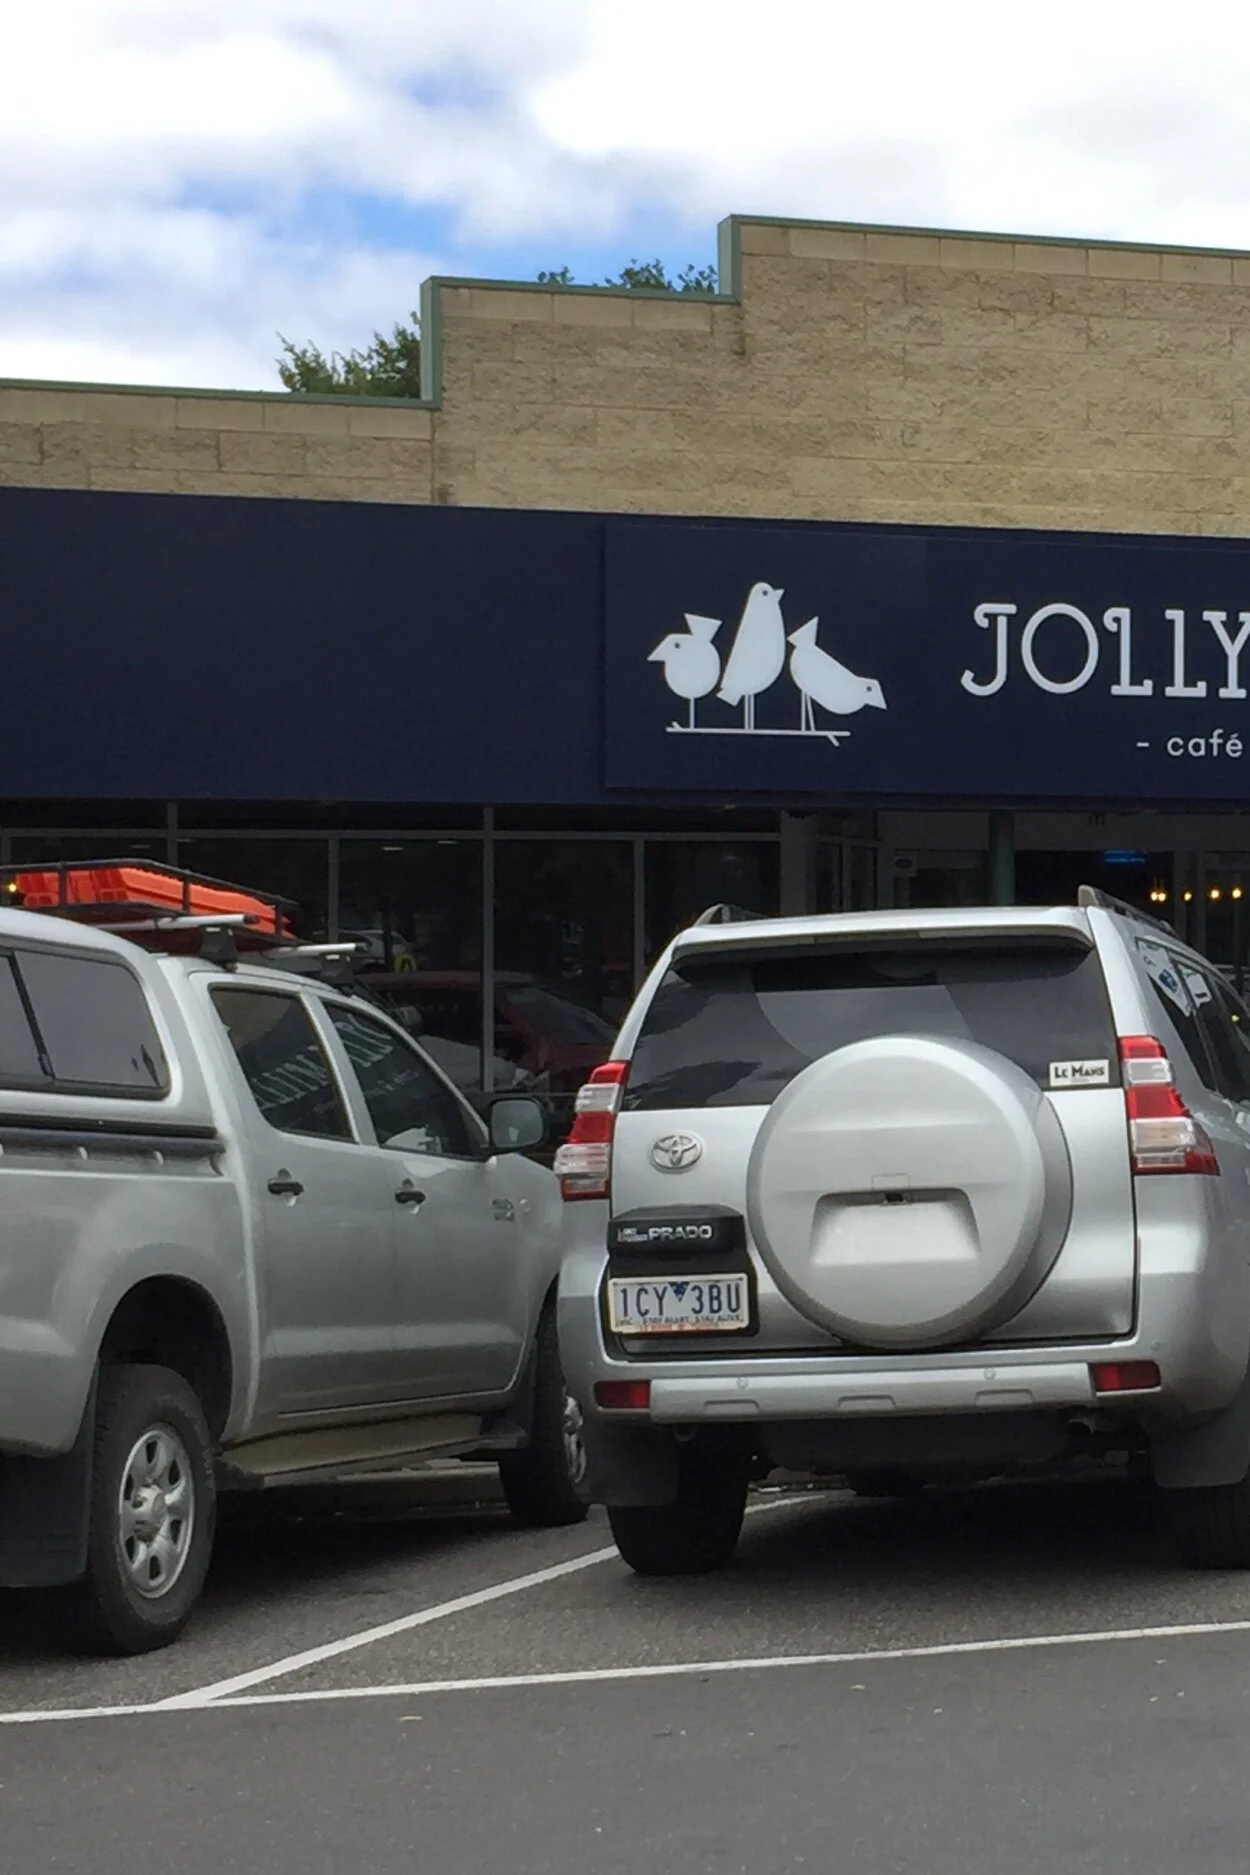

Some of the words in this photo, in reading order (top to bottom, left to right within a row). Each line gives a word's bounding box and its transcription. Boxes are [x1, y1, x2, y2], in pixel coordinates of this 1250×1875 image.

[1166, 729, 1243, 758] café
[648, 1224, 713, 1241] PRADO
[619, 1286, 668, 1318] 1CY
[690, 1282, 741, 1315] 3BU
